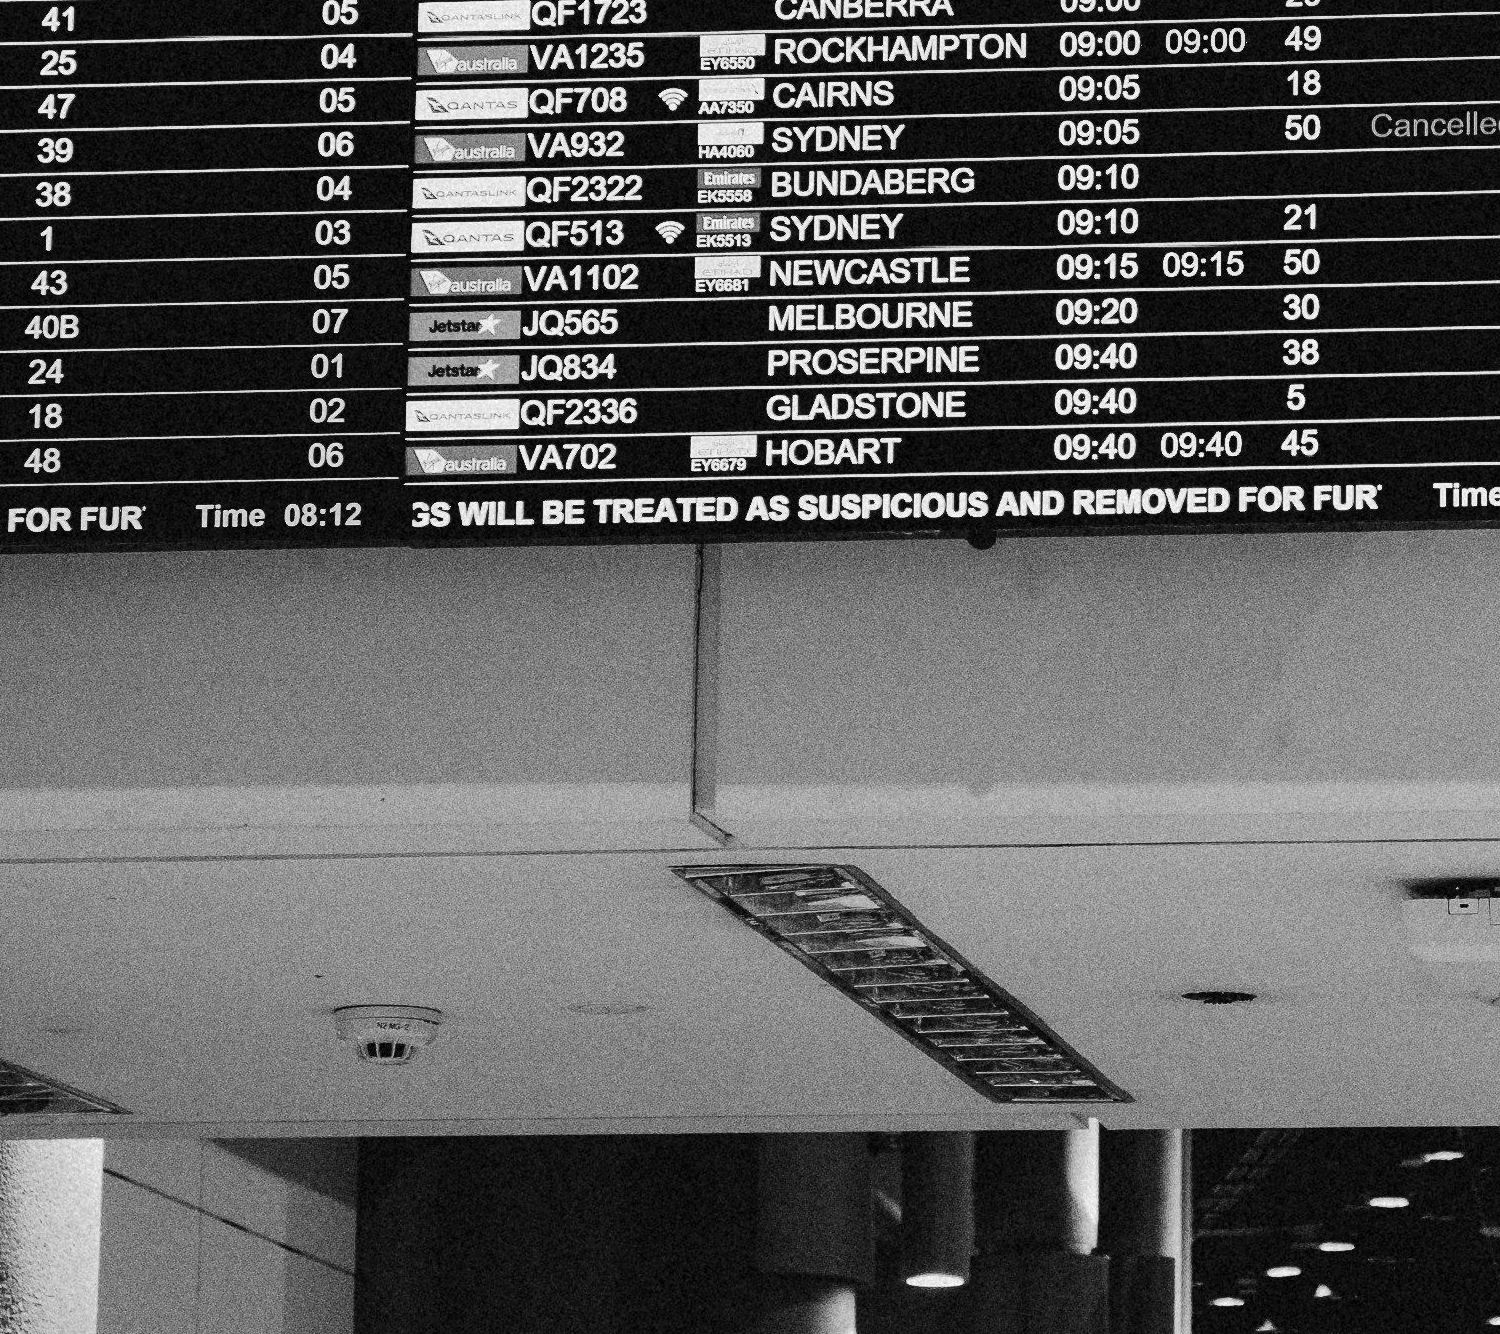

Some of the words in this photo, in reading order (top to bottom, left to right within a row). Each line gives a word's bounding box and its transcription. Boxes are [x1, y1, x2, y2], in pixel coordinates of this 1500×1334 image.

[37, 138, 73, 163] 39
[318, 131, 354, 157] 06
[41, 226, 52, 251] 1
[315, 220, 350, 245] 03
[521, 353, 617, 381] JQ834
[768, 346, 979, 376] PROSERPINE
[1055, 342, 1137, 370] 09:40
[1283, 339, 1319, 365] 38
[8, 507, 71, 532] FOR
[81, 506, 146, 531] FUR
[196, 504, 265, 527] Time
[284, 503, 361, 526] 08:12
[458, 501, 534, 526] WILL
[542, 499, 585, 525] BE
[593, 497, 738, 523] TREATED
[745, 495, 790, 521] AS
[798, 491, 989, 520] SUSPICIOUS
[996, 490, 1064, 516] AND
[1073, 487, 1230, 515] REMOVED
[1239, 486, 1305, 512] FOR
[1314, 484, 1382, 511] FUR
